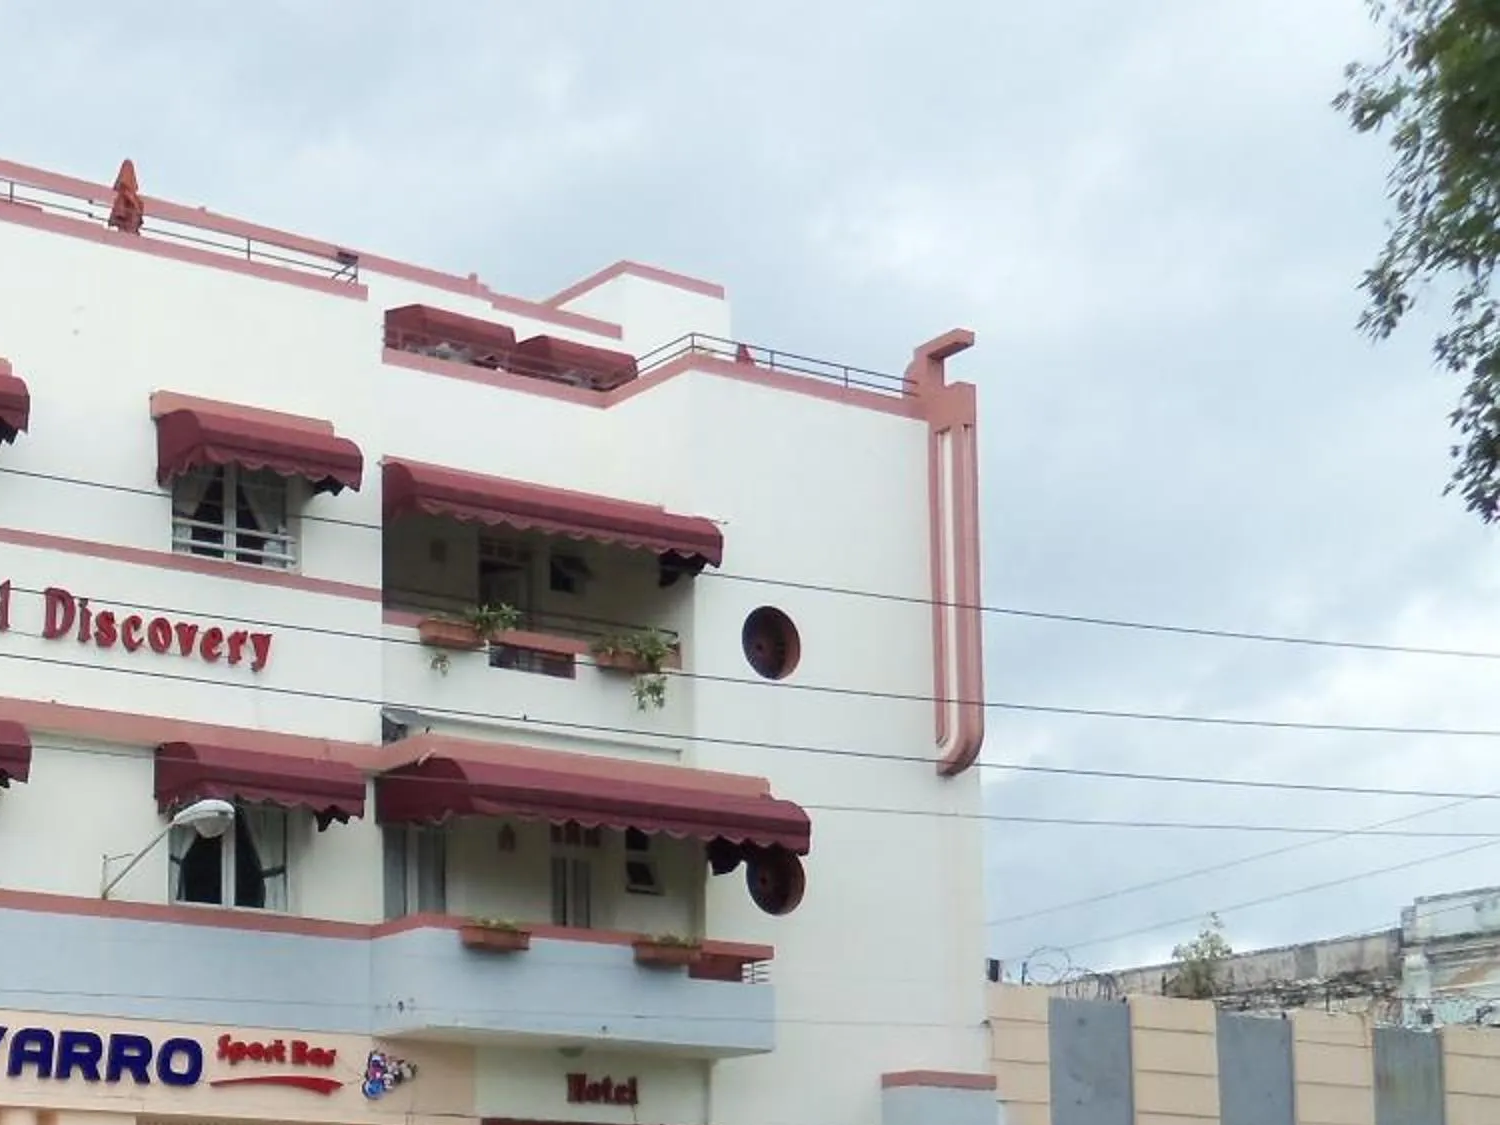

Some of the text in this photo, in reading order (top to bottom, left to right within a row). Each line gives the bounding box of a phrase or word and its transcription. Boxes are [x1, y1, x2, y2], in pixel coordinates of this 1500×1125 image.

[42, 586, 272, 673] Discovery
[217, 1034, 285, 1066] Sport
[291, 1039, 337, 1068] Bar
[566, 1073, 638, 1106] Hotel
